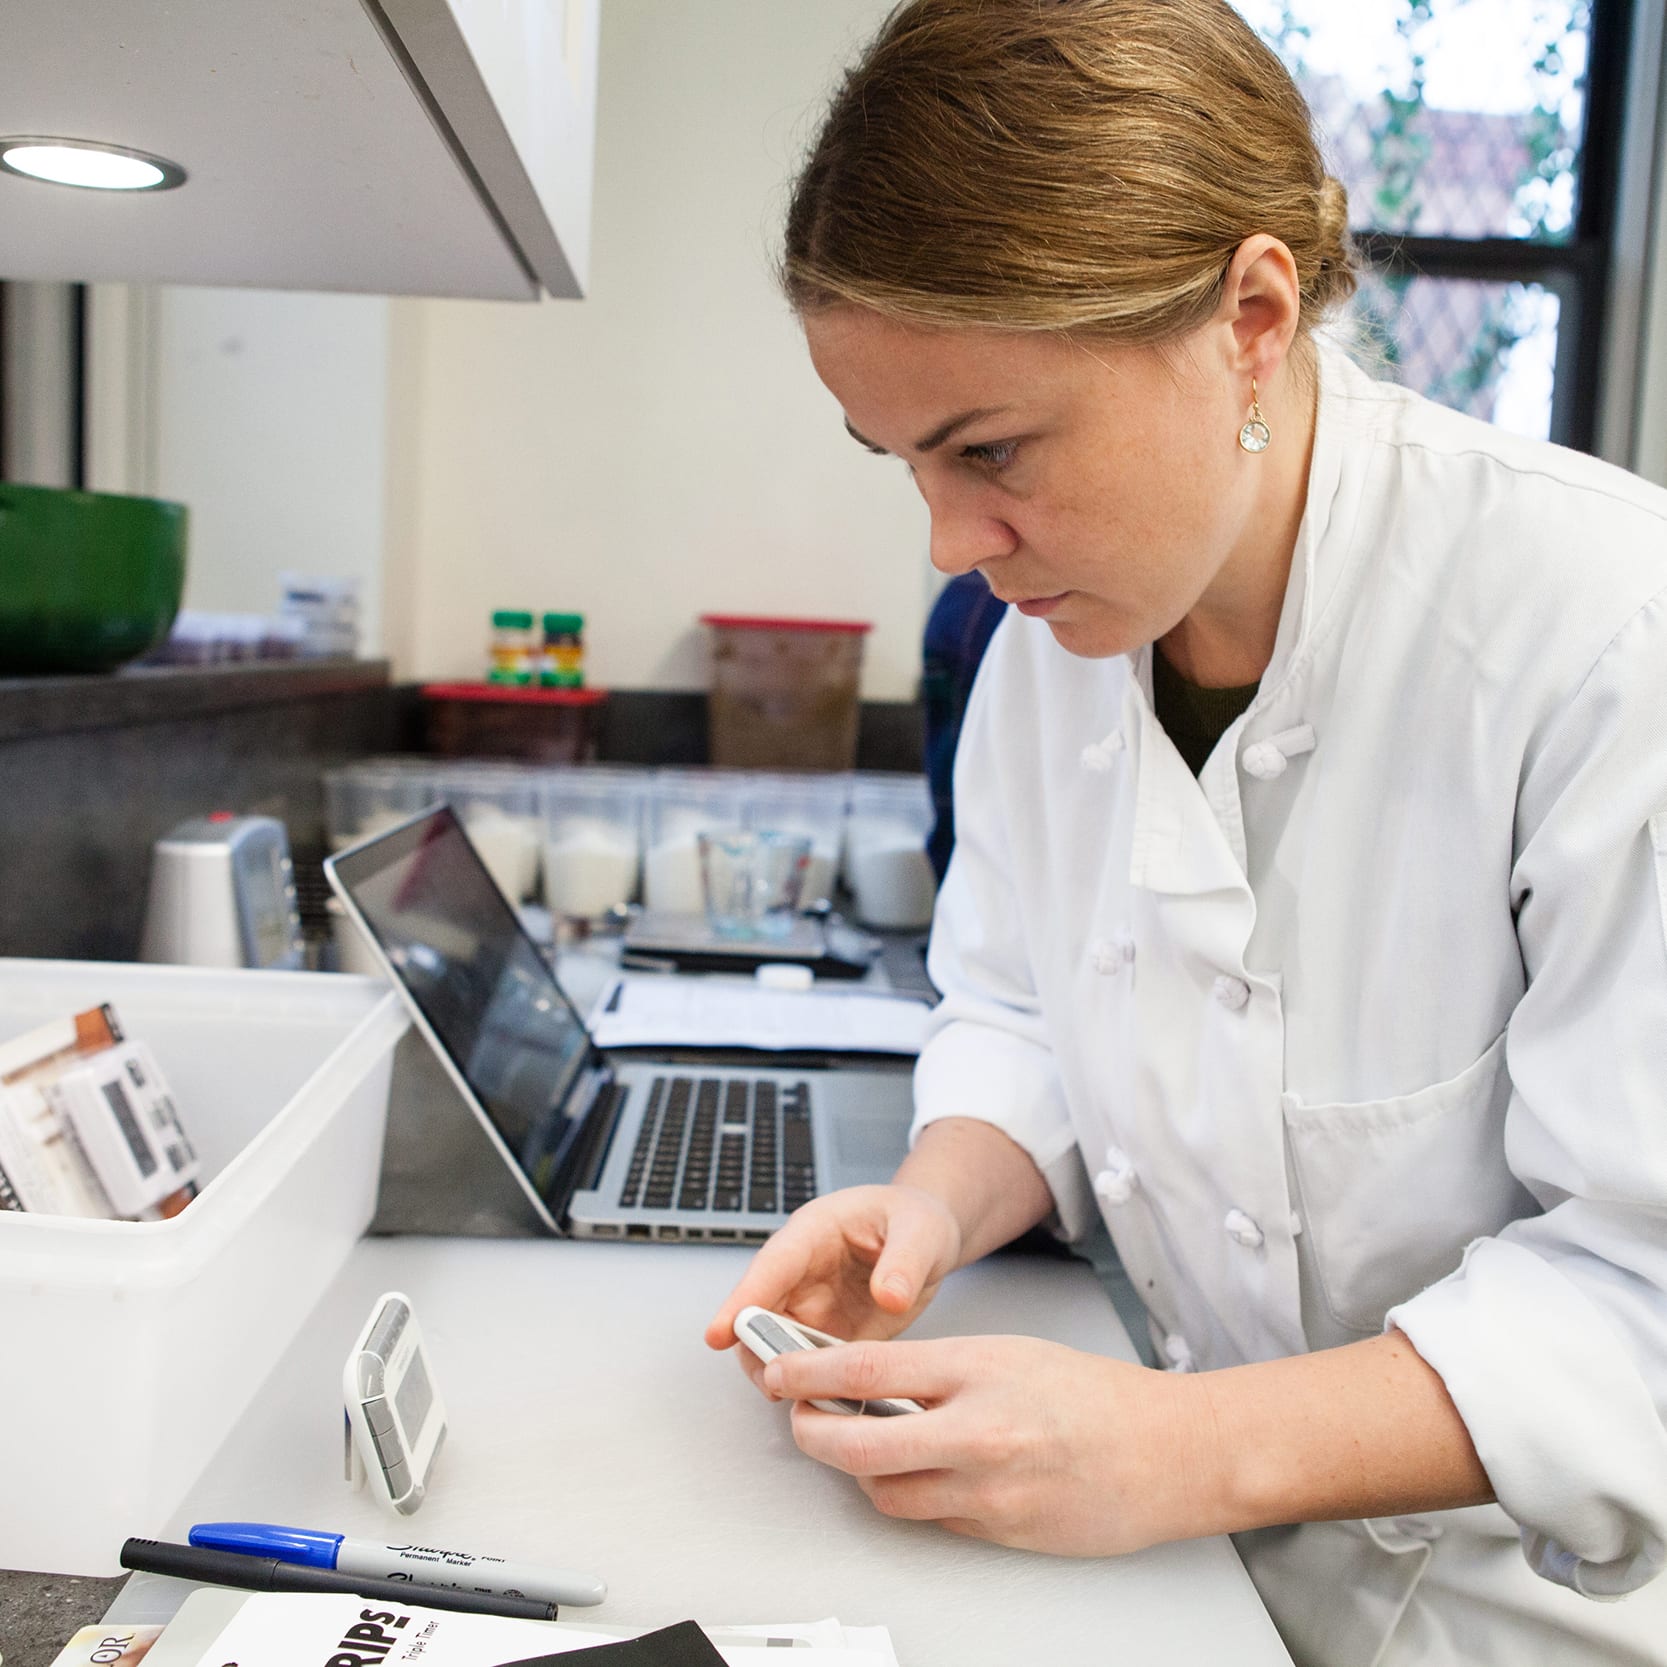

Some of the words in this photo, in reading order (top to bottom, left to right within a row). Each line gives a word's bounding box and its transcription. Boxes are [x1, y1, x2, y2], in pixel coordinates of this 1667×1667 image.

[400, 1551, 439, 1563] Permanent
[446, 1557, 472, 1567] Marker
[90, 1632, 136, 1667] OR
[401, 1641, 427, 1661] Triple
[415, 1620, 440, 1640] Timer
